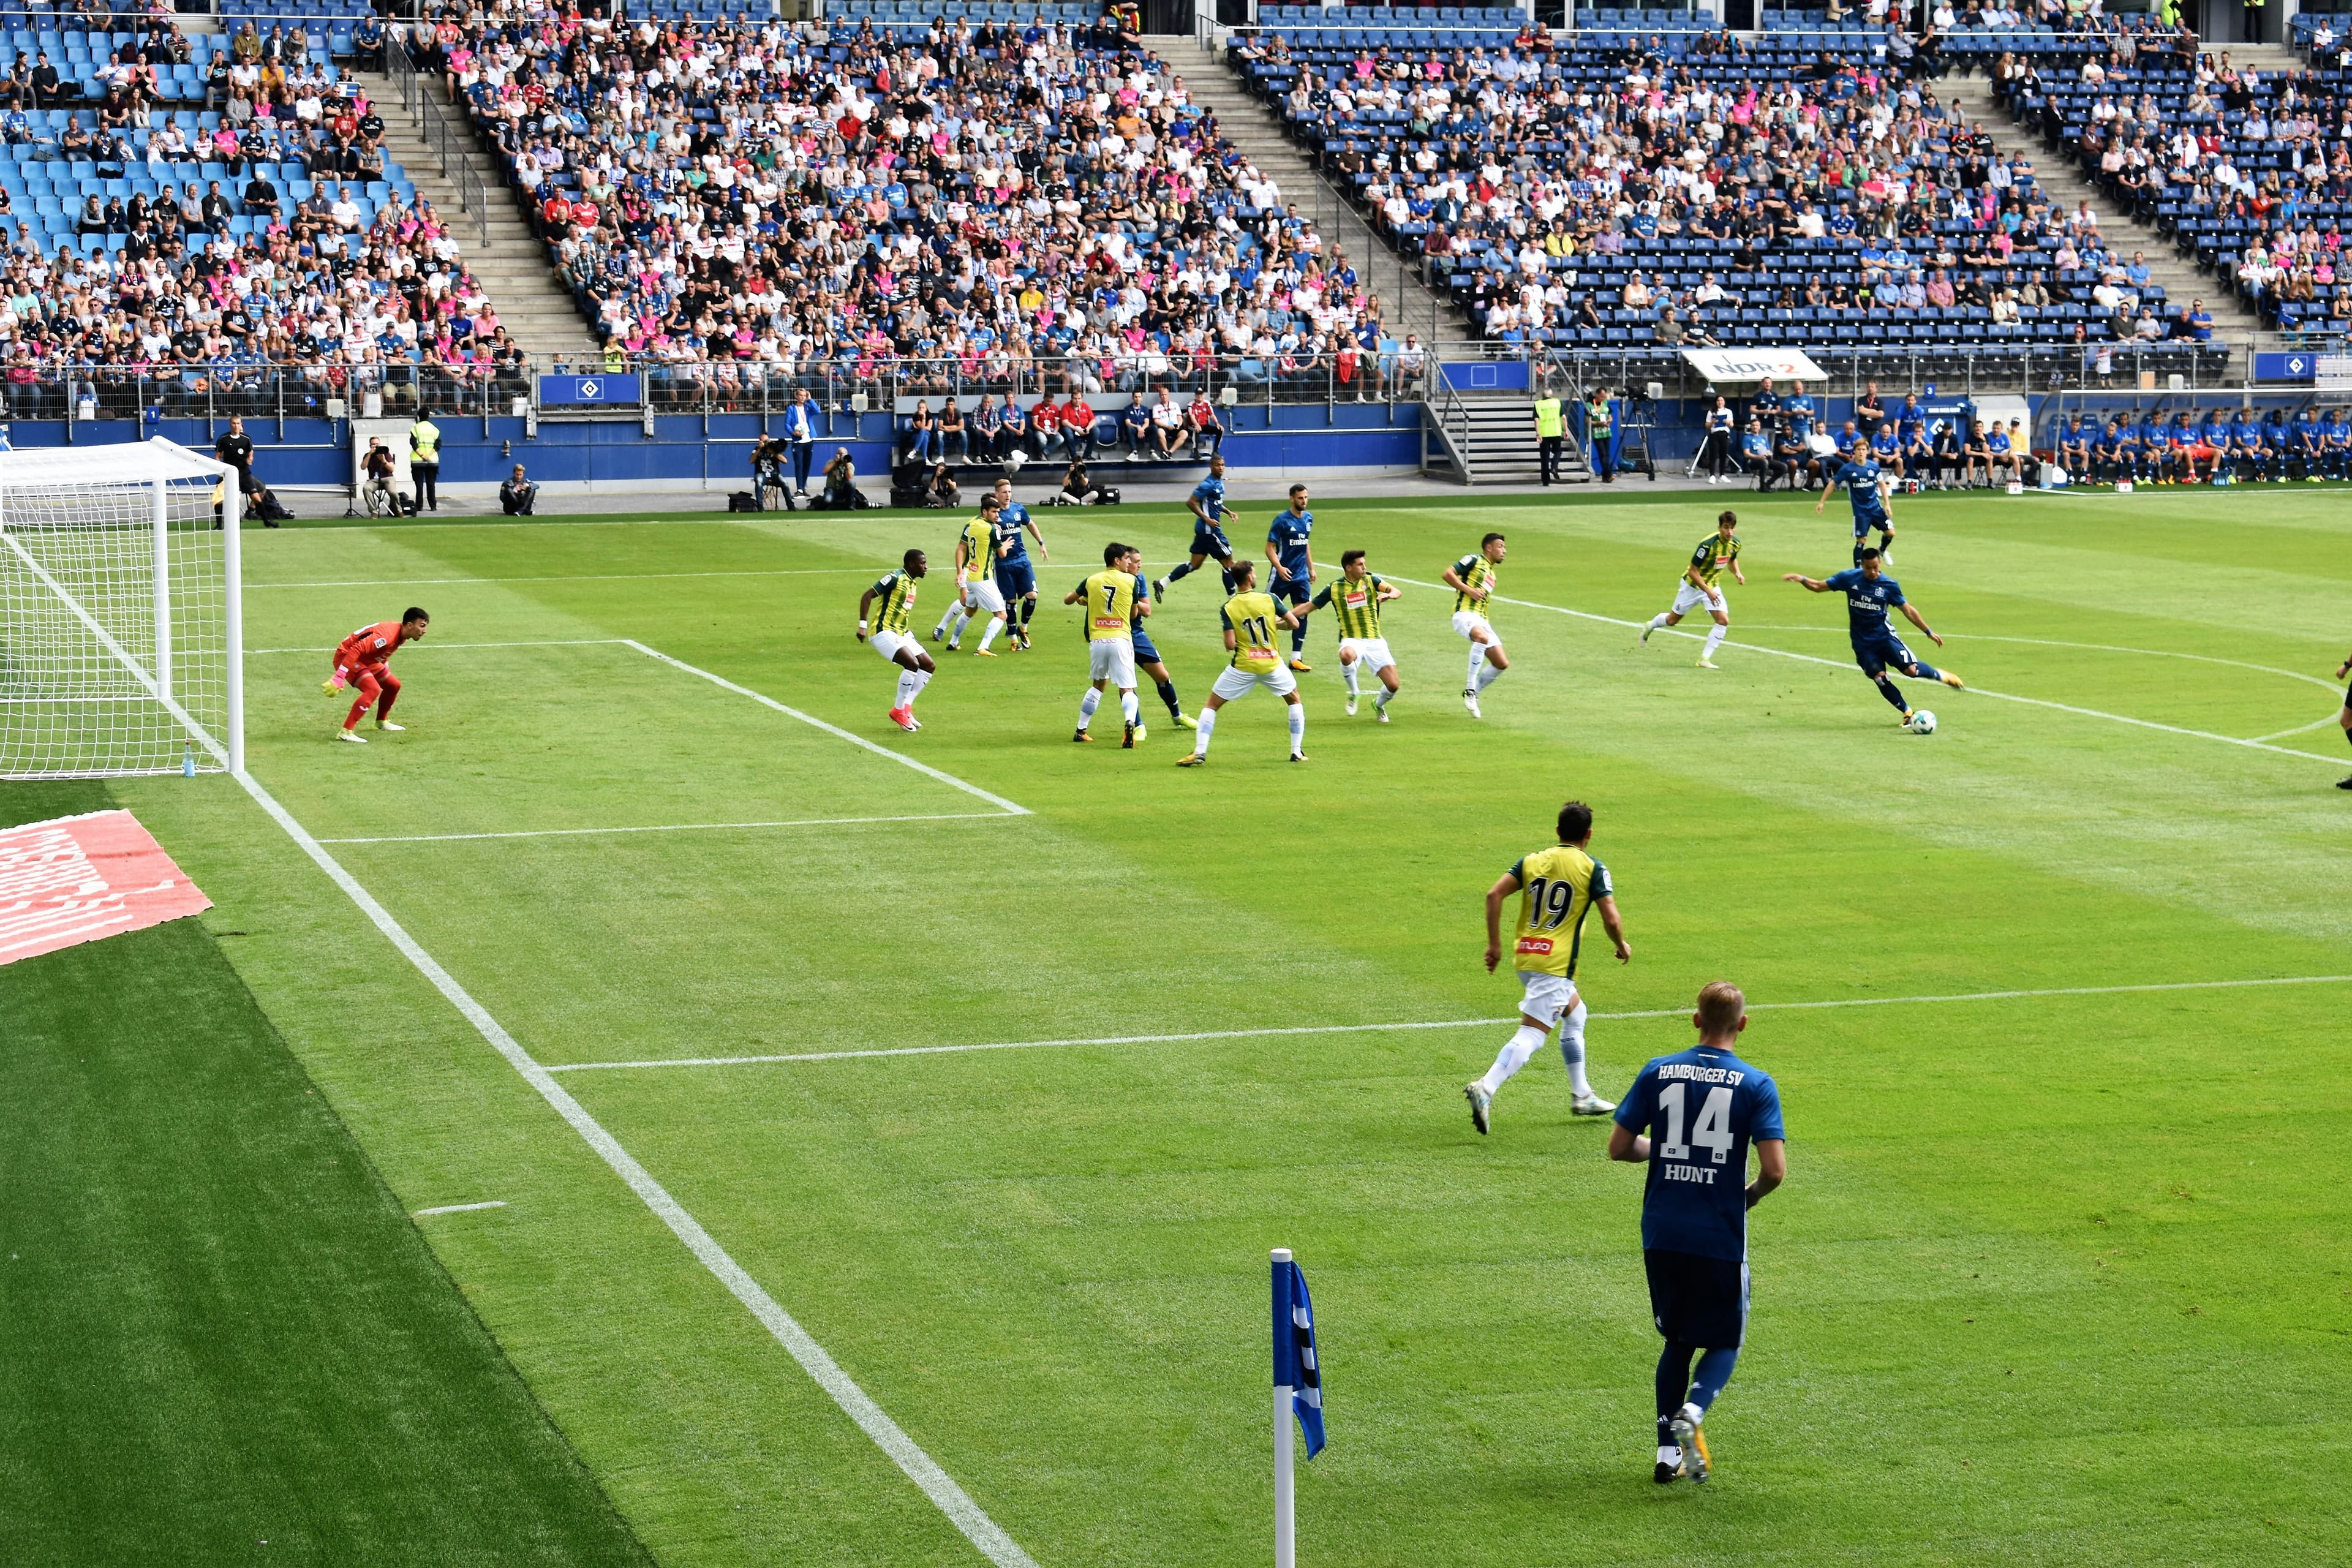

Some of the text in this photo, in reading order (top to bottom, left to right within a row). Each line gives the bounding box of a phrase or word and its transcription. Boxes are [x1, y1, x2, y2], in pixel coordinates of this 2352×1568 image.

[1713, 358, 1800, 375] NDR 2
[970, 536, 976, 559] 3
[1101, 584, 1117, 614] 7
[1850, 599, 1881, 611] Emirates
[1861, 595, 1872, 603] Fly
[1242, 616, 1270, 647] 11
[1529, 876, 1575, 930] 19
[1658, 1065, 1744, 1086] HAMBURGER SV
[1659, 1082, 1734, 1164] 14
[1664, 1164, 1717, 1184] HUNT
